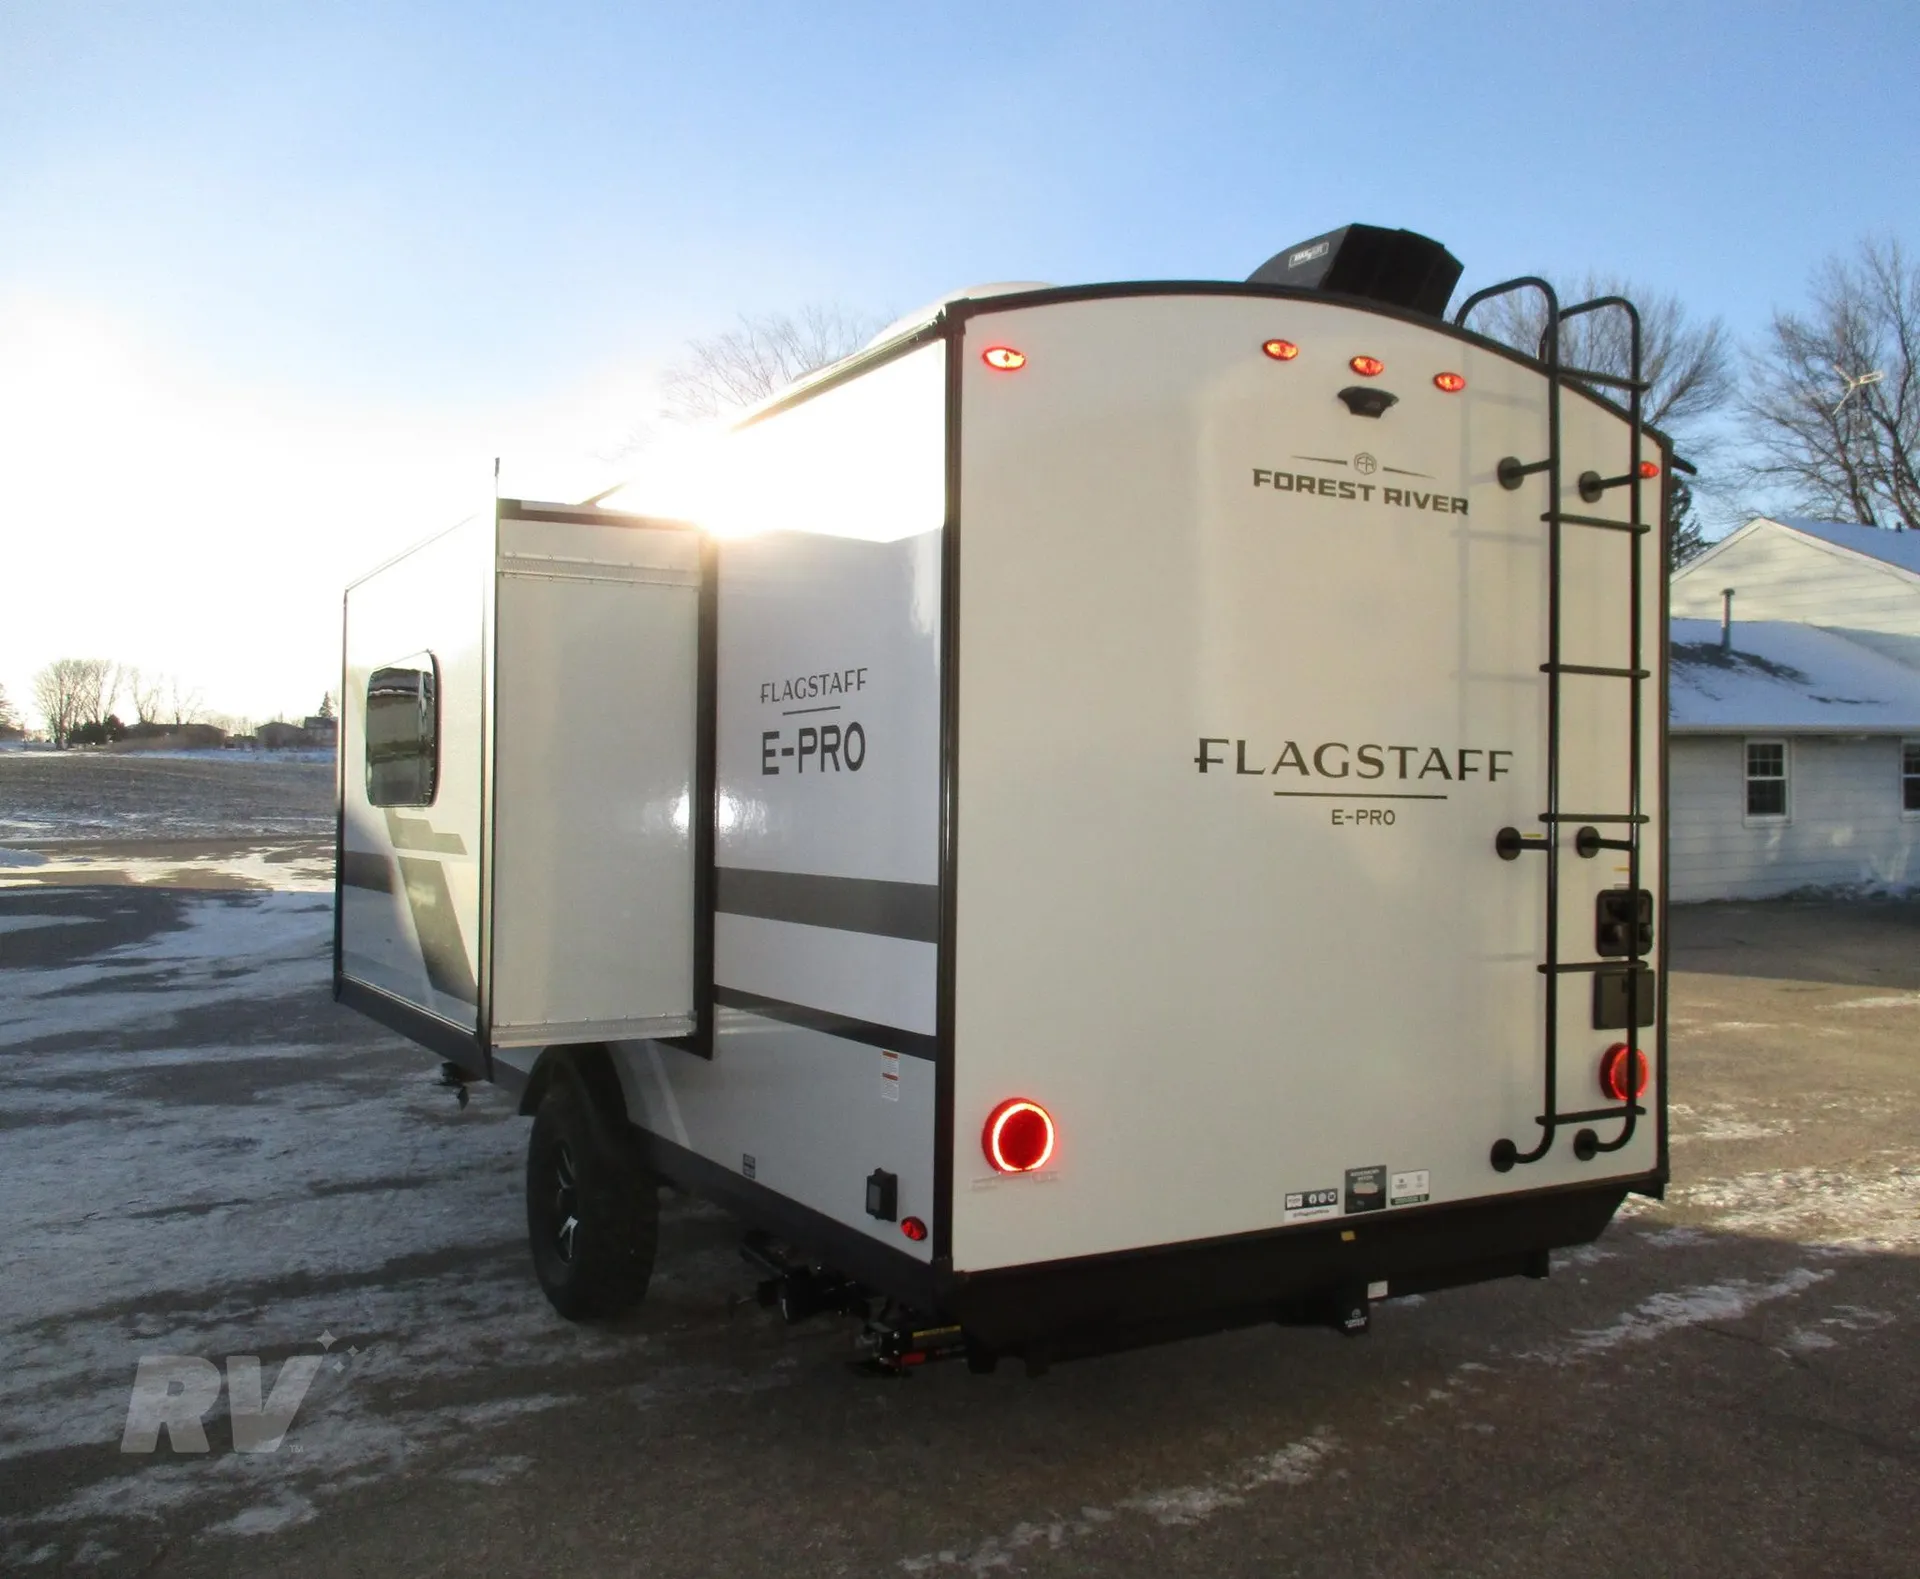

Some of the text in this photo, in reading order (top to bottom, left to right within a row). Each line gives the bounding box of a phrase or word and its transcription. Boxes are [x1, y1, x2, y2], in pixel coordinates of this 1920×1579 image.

[1252, 468, 1469, 515] FOREST RIVER
[760, 667, 868, 704] FLAGSTAFF
[762, 721, 866, 775] E-PRO
[1193, 737, 1514, 782] FLAGSTAFF
[1331, 809, 1396, 826] E-PRO
